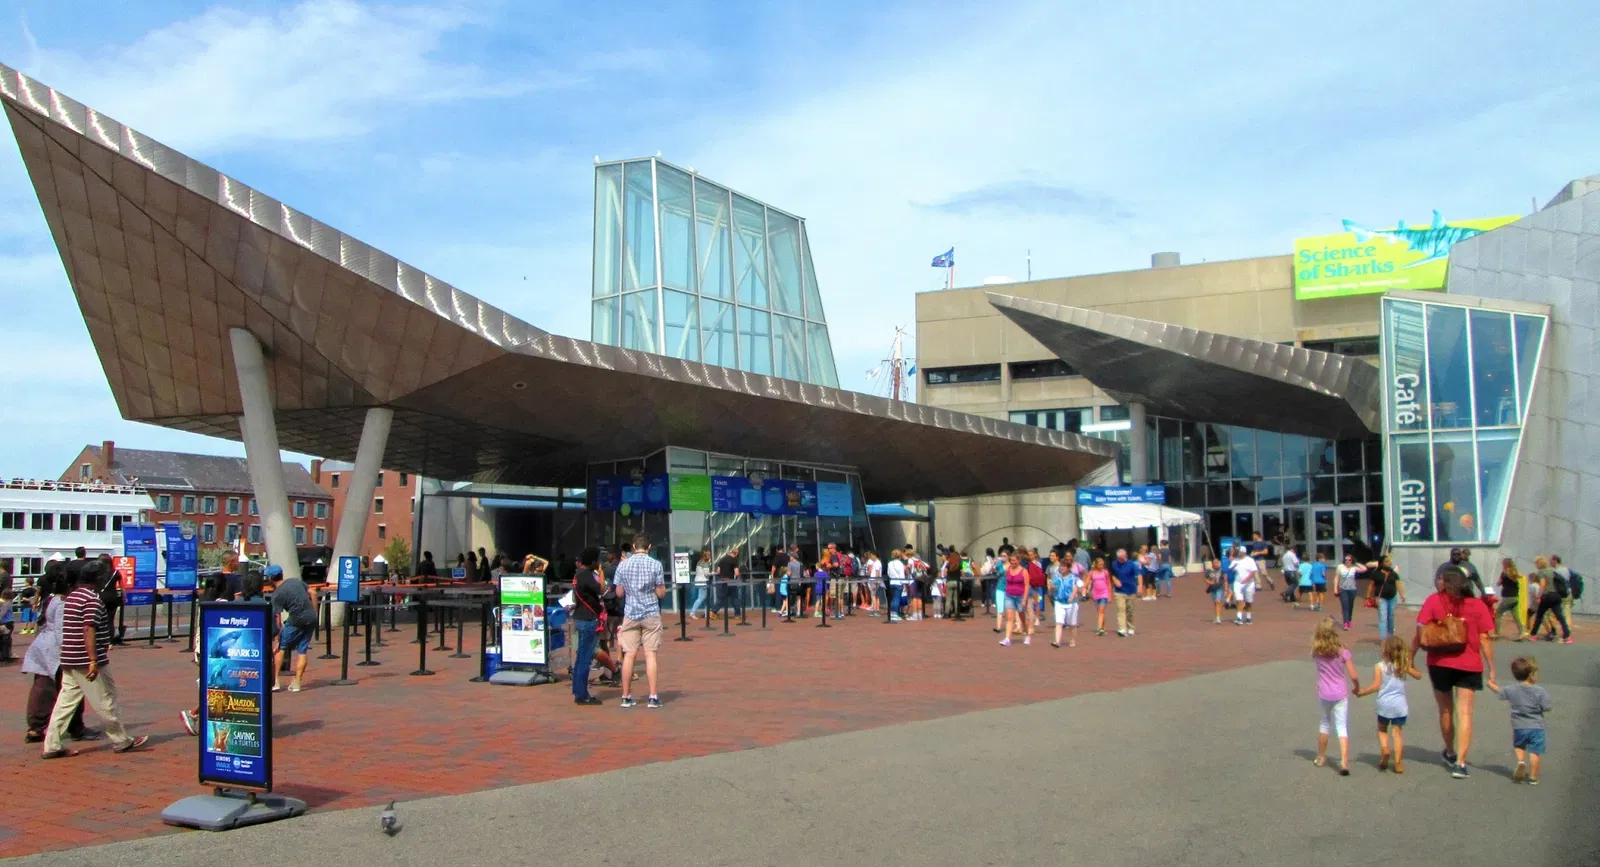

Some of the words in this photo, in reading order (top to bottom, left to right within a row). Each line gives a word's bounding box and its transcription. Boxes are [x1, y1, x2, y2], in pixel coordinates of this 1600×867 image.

[1299, 245, 1376, 264] Science
[1299, 264, 1320, 280] of
[1324, 259, 1394, 278] Sharks
[1395, 373, 1422, 425] Café
[1399, 479, 1426, 535] Gifts
[230, 617, 249, 627] Playing!
[227, 648, 250, 657] SHARK
[250, 649, 260, 658] 3D
[233, 731, 255, 741] SAVING
[238, 740, 260, 748] TURTLES
